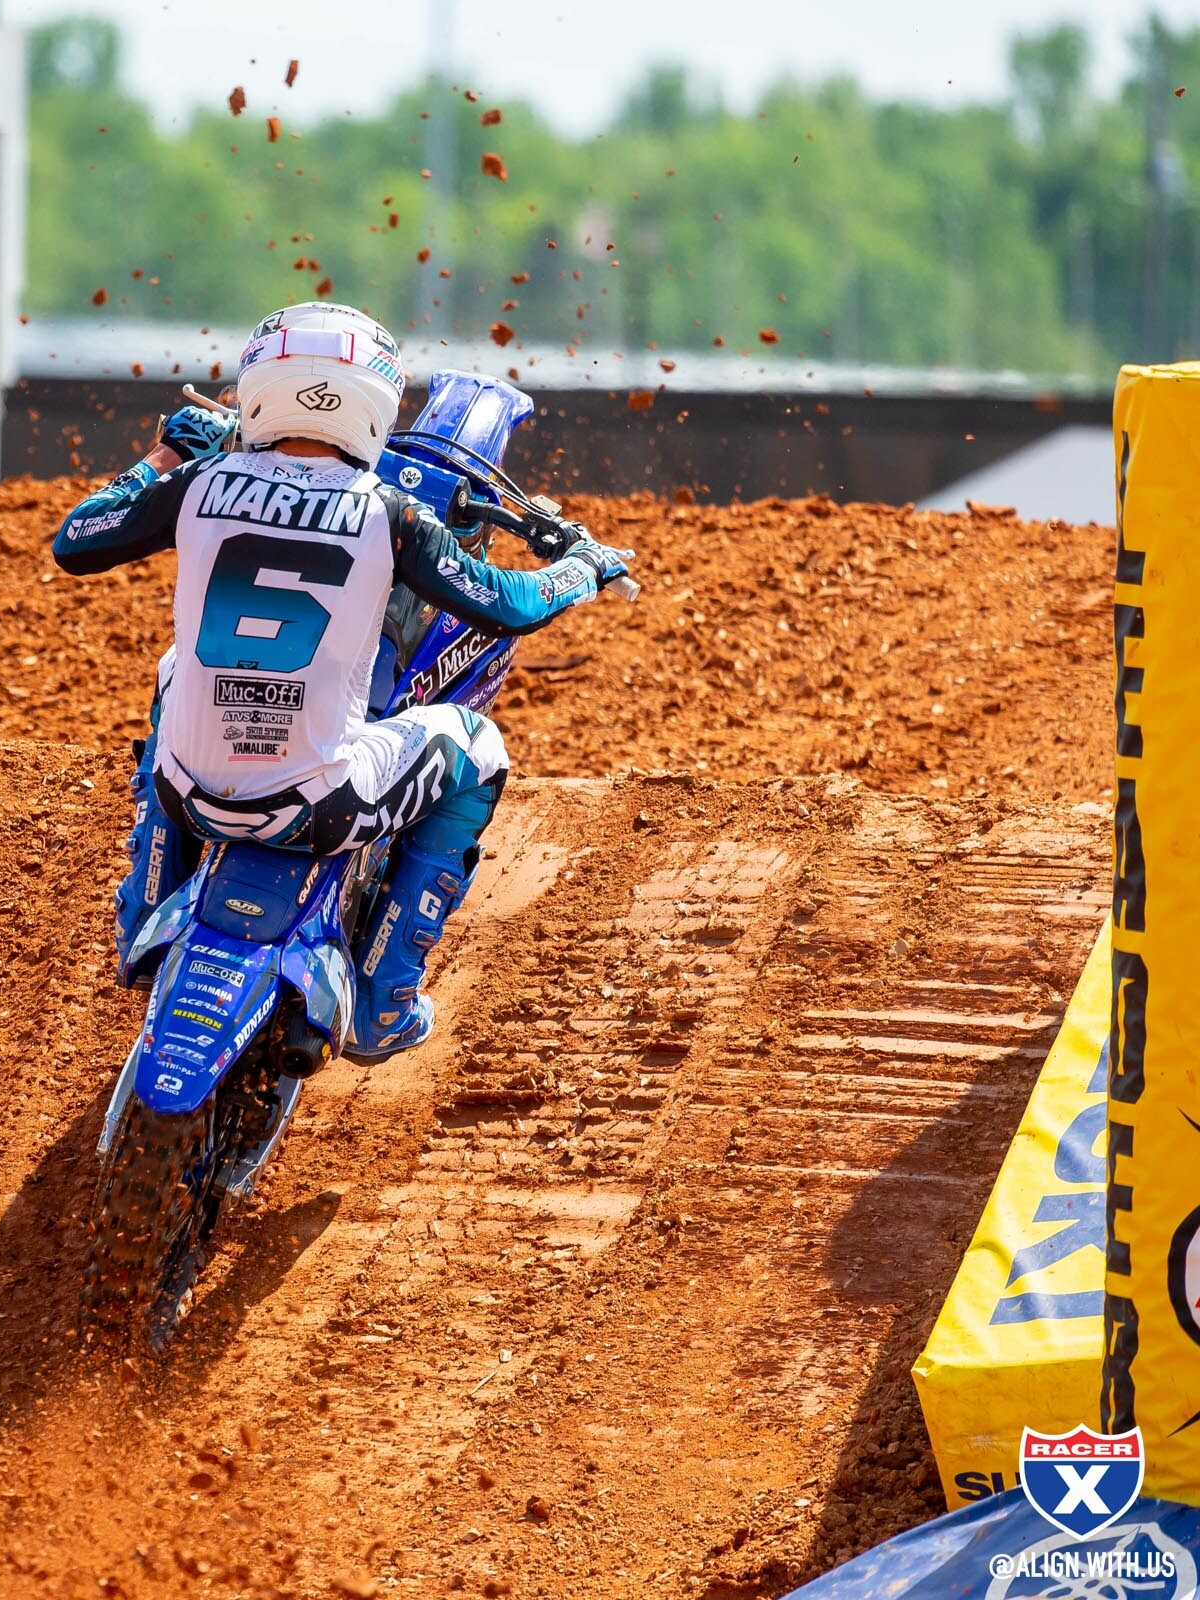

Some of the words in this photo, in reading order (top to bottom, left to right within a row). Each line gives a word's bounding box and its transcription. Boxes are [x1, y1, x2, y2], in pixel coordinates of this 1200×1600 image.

[200, 473, 368, 534] MARTIN
[195, 532, 355, 673] 6
[220, 682, 300, 706] Muc-Off
[232, 743, 278, 755] YAMALUBE
[196, 983, 233, 1003] YAMAHA
[173, 1009, 223, 1029] HINSON
[233, 990, 276, 1051] DUNLOP
